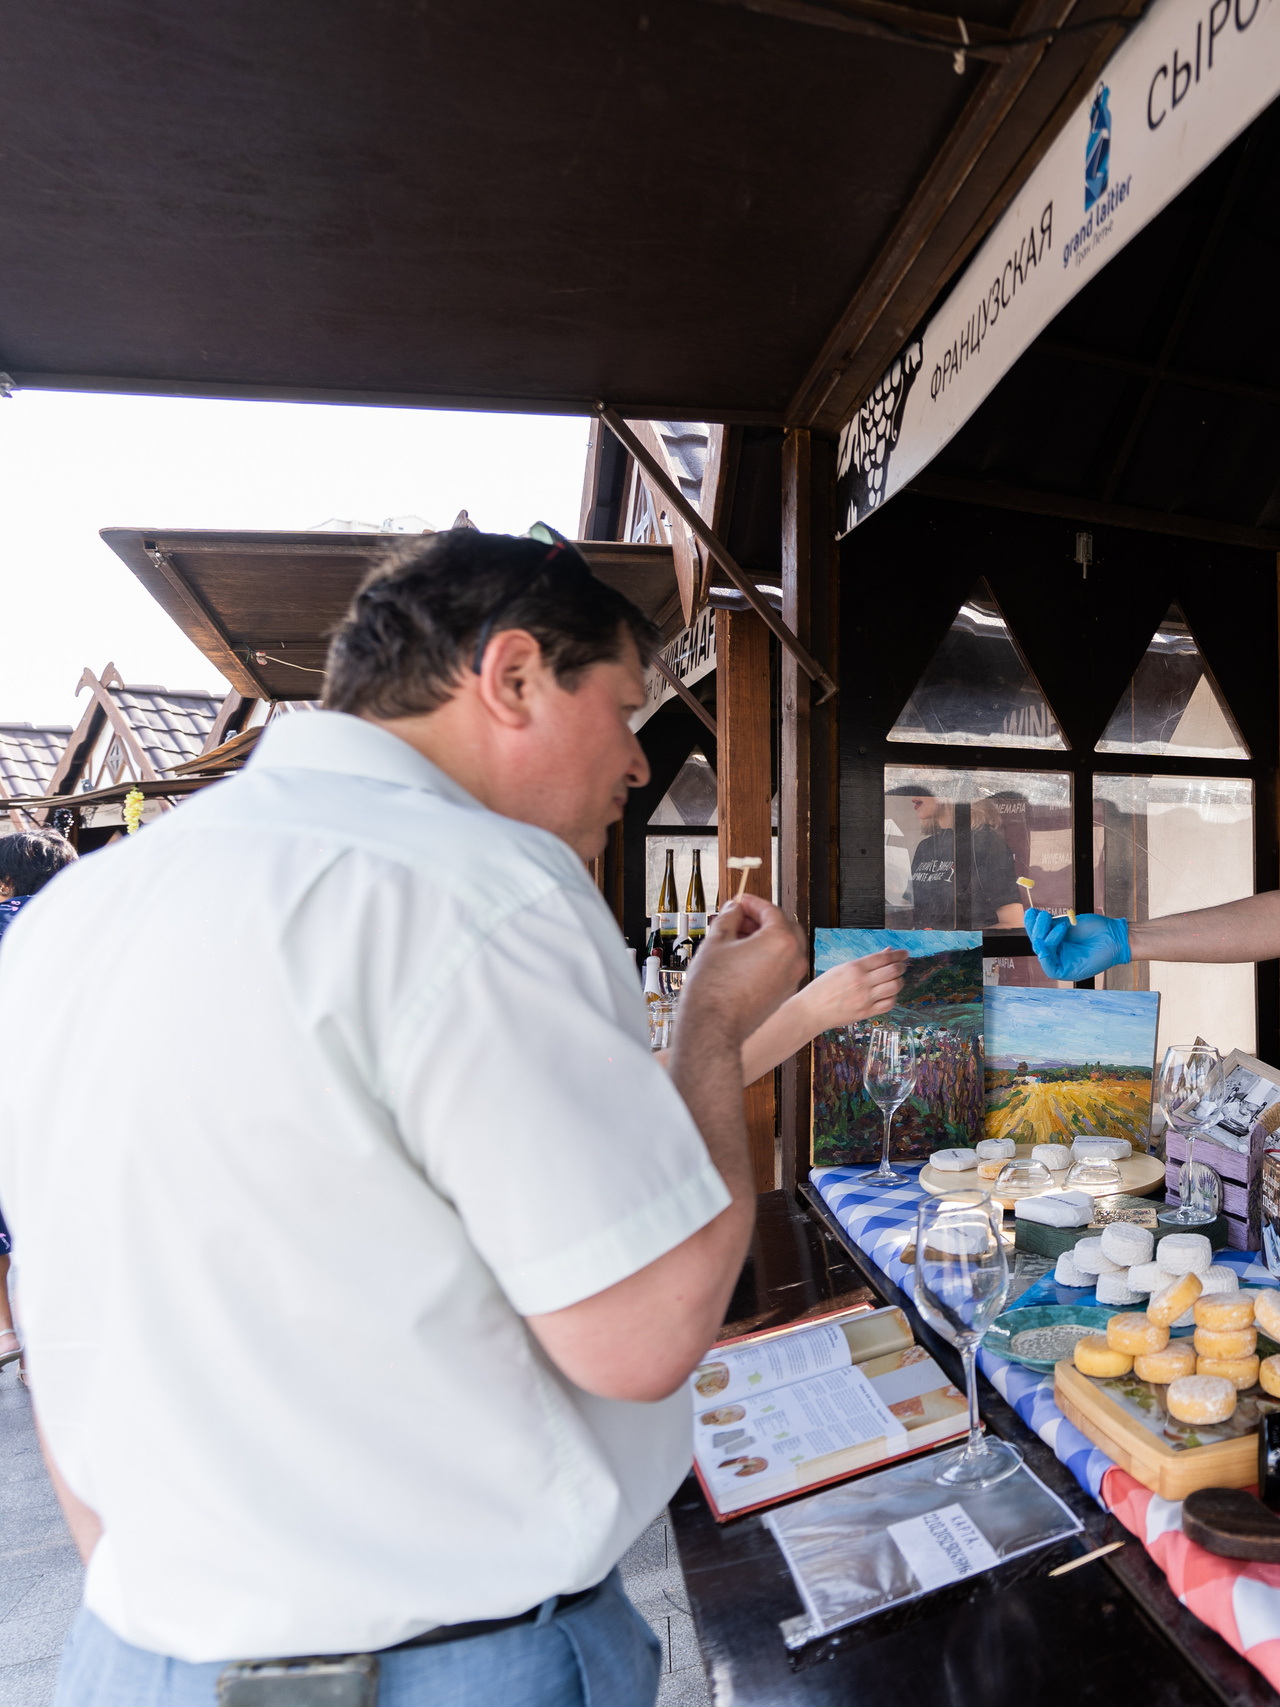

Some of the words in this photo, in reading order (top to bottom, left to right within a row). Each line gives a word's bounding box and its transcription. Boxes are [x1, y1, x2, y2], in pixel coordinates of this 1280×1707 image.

[1147, 0, 1264, 131] СЫРО
[1063, 212, 1093, 269] grand
[1096, 174, 1132, 227] laitier
[931, 201, 1053, 402] ФРАНЦУЗСКАЯ
